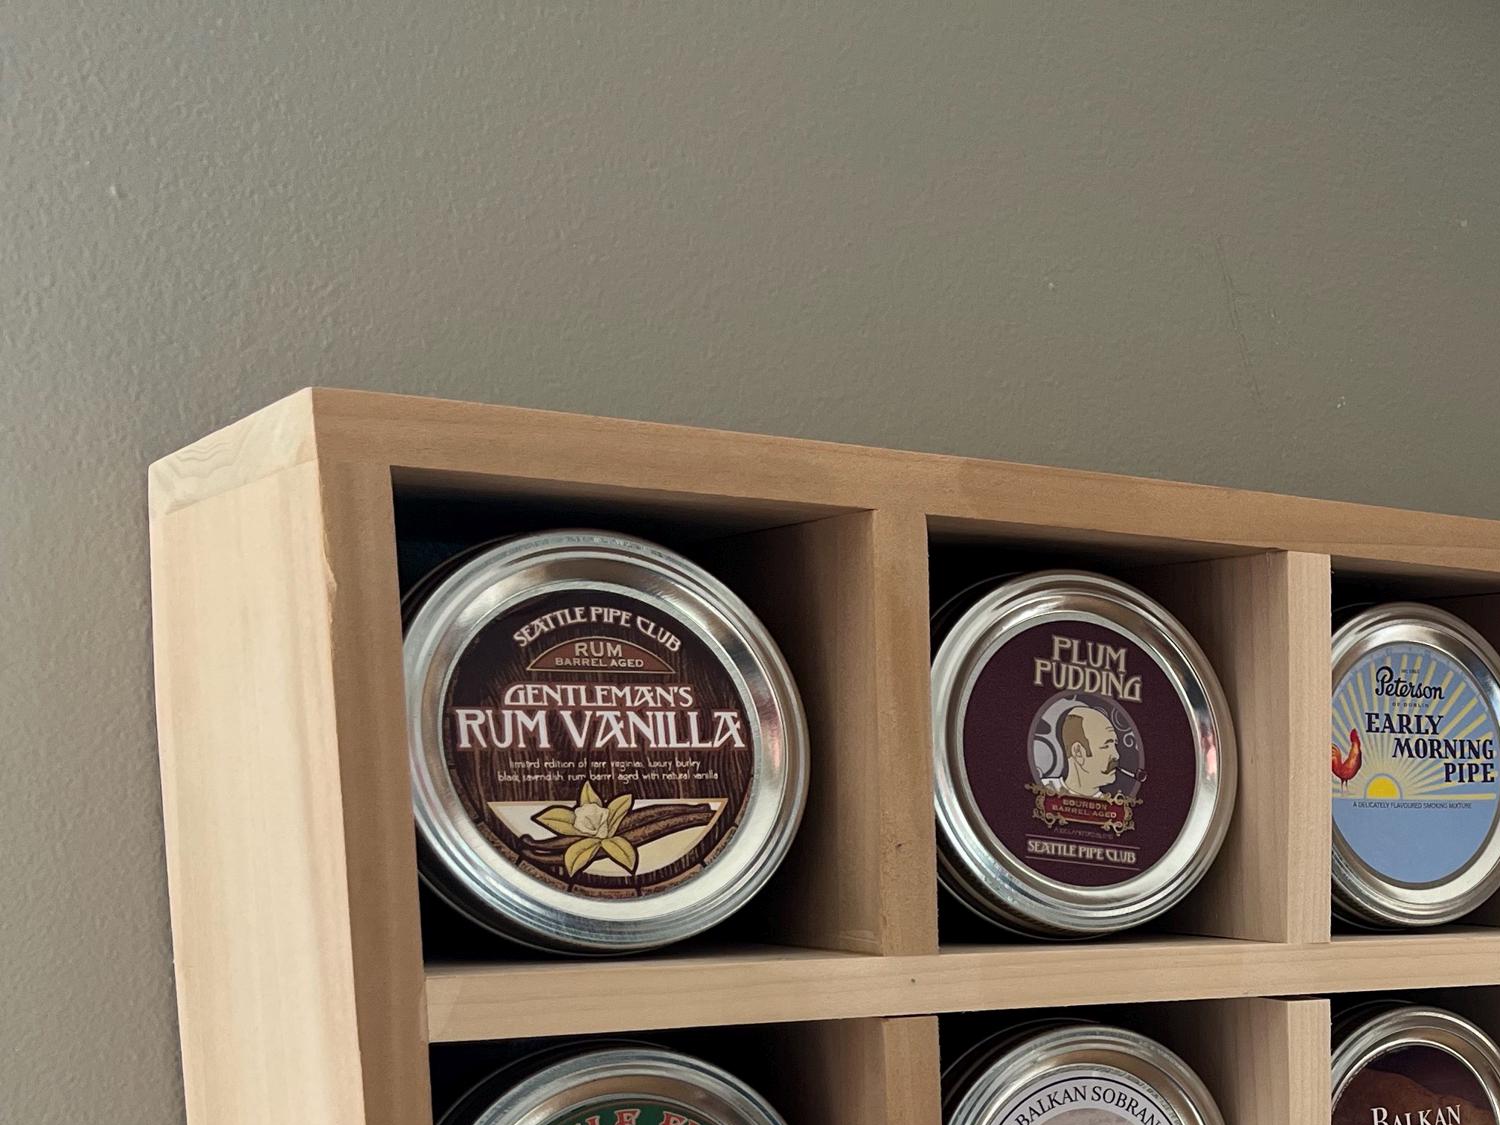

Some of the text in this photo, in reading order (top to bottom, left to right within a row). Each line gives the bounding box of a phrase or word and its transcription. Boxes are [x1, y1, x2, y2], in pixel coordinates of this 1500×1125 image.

[513, 606, 682, 652] SEATTLE PIPE CLUB
[575, 641, 623, 658] RUM
[1052, 635, 1127, 674] PLUM
[555, 657, 644, 668] BARREL AGED
[1033, 657, 1142, 703] PUDDING
[1375, 665, 1445, 700] Peterson
[504, 684, 693, 707] GENTLEMAN'S
[455, 709, 747, 749] RUM VANILLA
[1365, 712, 1444, 735] EARLY
[1392, 738, 1494, 760] MORNING
[544, 759, 575, 769] edition
[1444, 763, 1495, 783] PIPE
[1027, 839, 1137, 864] SEATTLE PIPE CLUB
